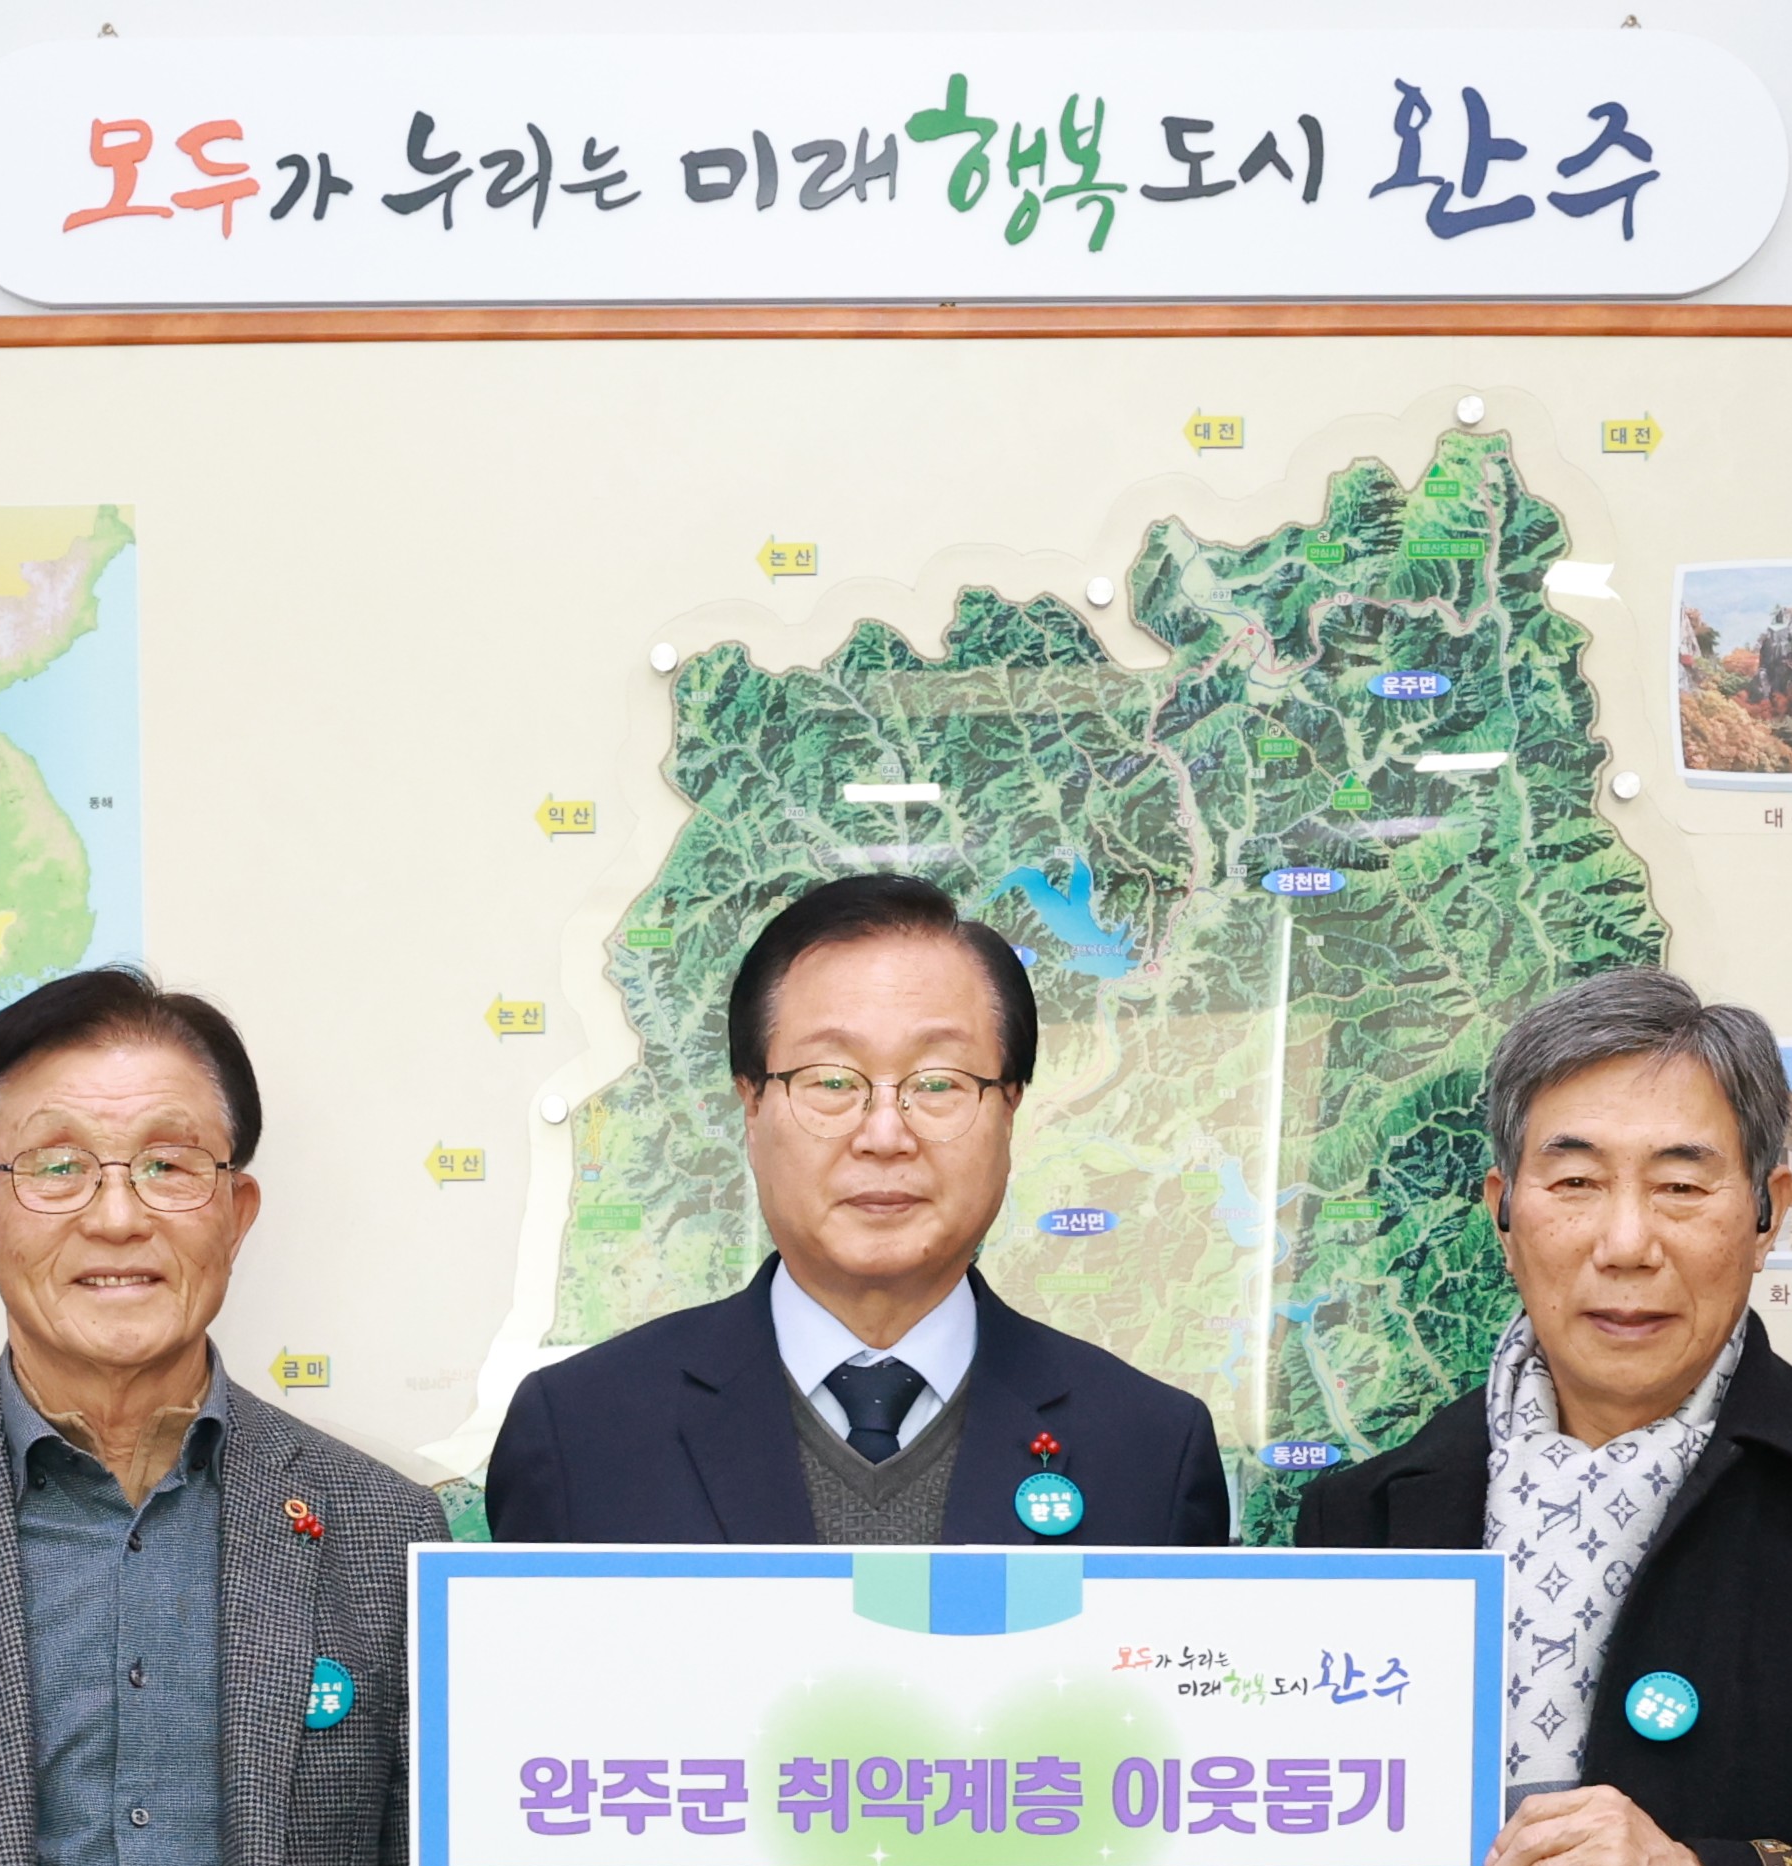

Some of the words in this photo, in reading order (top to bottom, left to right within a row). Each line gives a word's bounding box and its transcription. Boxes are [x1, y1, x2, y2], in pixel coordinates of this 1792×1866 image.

[62, 118, 353, 240] 모두가
[381, 111, 645, 232] 누리는
[1369, 78, 1664, 242] 완주
[1382, 676, 1437, 694] 운주면
[89, 797, 114, 810] 동해
[1277, 873, 1331, 892] 경천면
[1051, 1214, 1105, 1232] 고산면
[1272, 1446, 1326, 1465] 동상면
[1112, 1647, 1172, 1672] 모두가
[1178, 1646, 1230, 1671] 누리는
[1312, 1648, 1411, 1705] 완주
[518, 1756, 749, 1837] 완주군
[776, 1756, 1084, 1836] 취약계층
[1112, 1755, 1406, 1836] 이웃돕기
